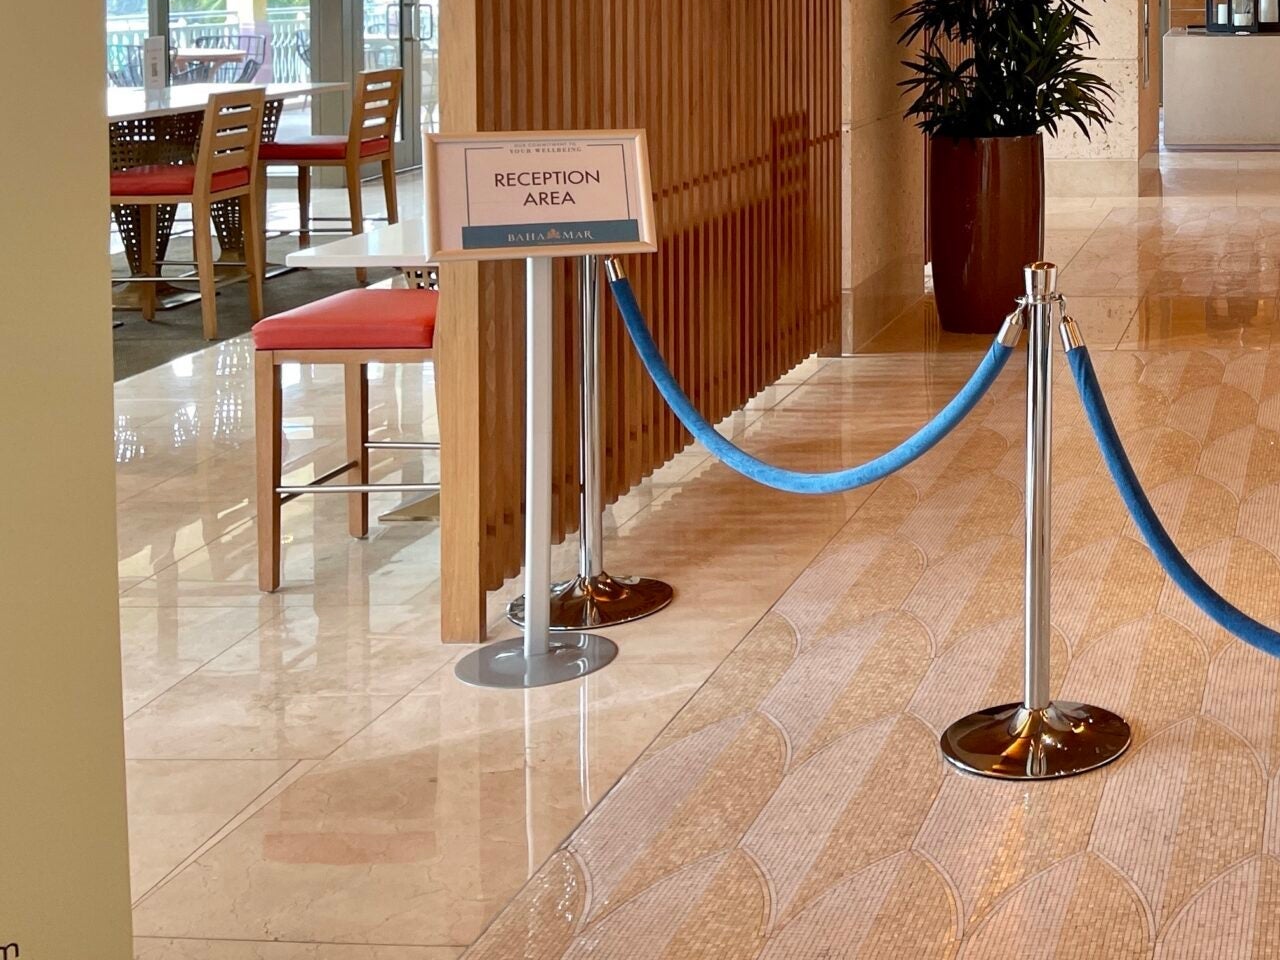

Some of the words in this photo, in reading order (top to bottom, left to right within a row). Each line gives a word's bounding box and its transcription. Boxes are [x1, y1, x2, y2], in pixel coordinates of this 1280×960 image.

[494, 170, 600, 187] RECEPTION
[523, 191, 576, 206] AREA
[508, 232, 545, 242] BAHA
[562, 230, 593, 240] MAR
